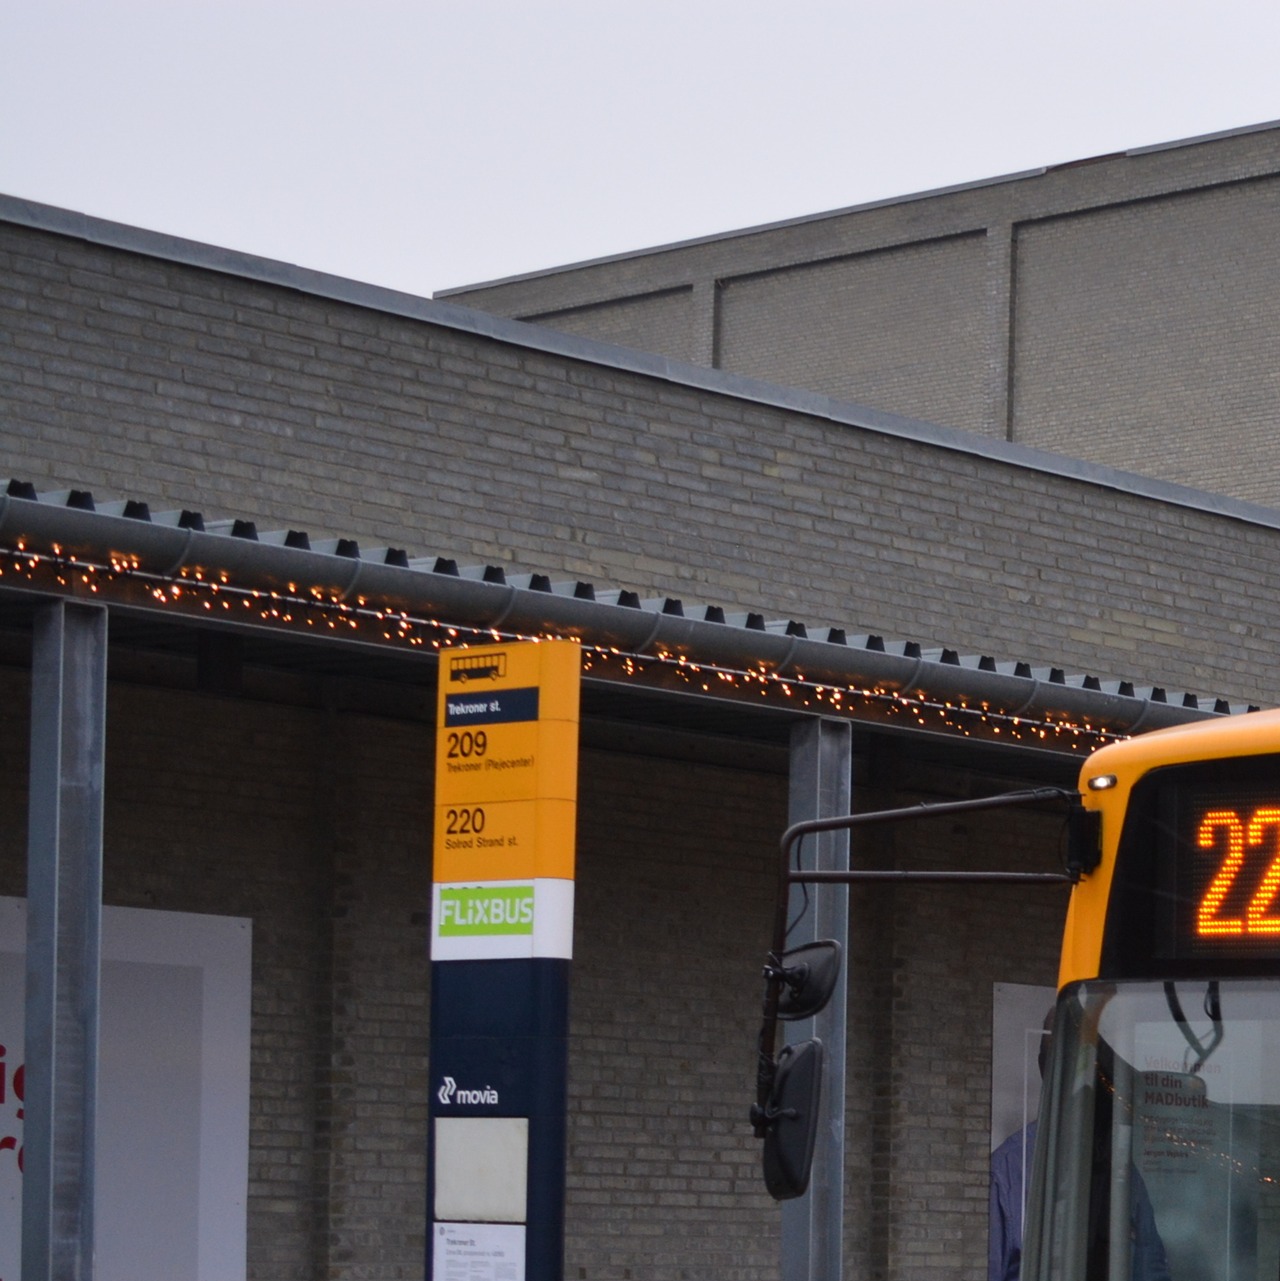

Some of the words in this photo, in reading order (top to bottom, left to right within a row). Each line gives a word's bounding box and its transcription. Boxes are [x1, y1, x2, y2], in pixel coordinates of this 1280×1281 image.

[448, 703, 487, 715] Trekroner
[489, 700, 501, 712] st.
[447, 730, 487, 758] 209
[446, 762, 481, 773] Trekroner
[446, 807, 485, 835] 220
[445, 836, 474, 849] Solrød
[476, 834, 504, 848] Strand
[507, 834, 518, 847] st.
[1144, 1073, 1158, 1087] til
[1161, 1075, 1182, 1089] din
[457, 1084, 498, 1105] movia
[1144, 1091, 1209, 1108] MADbutik
